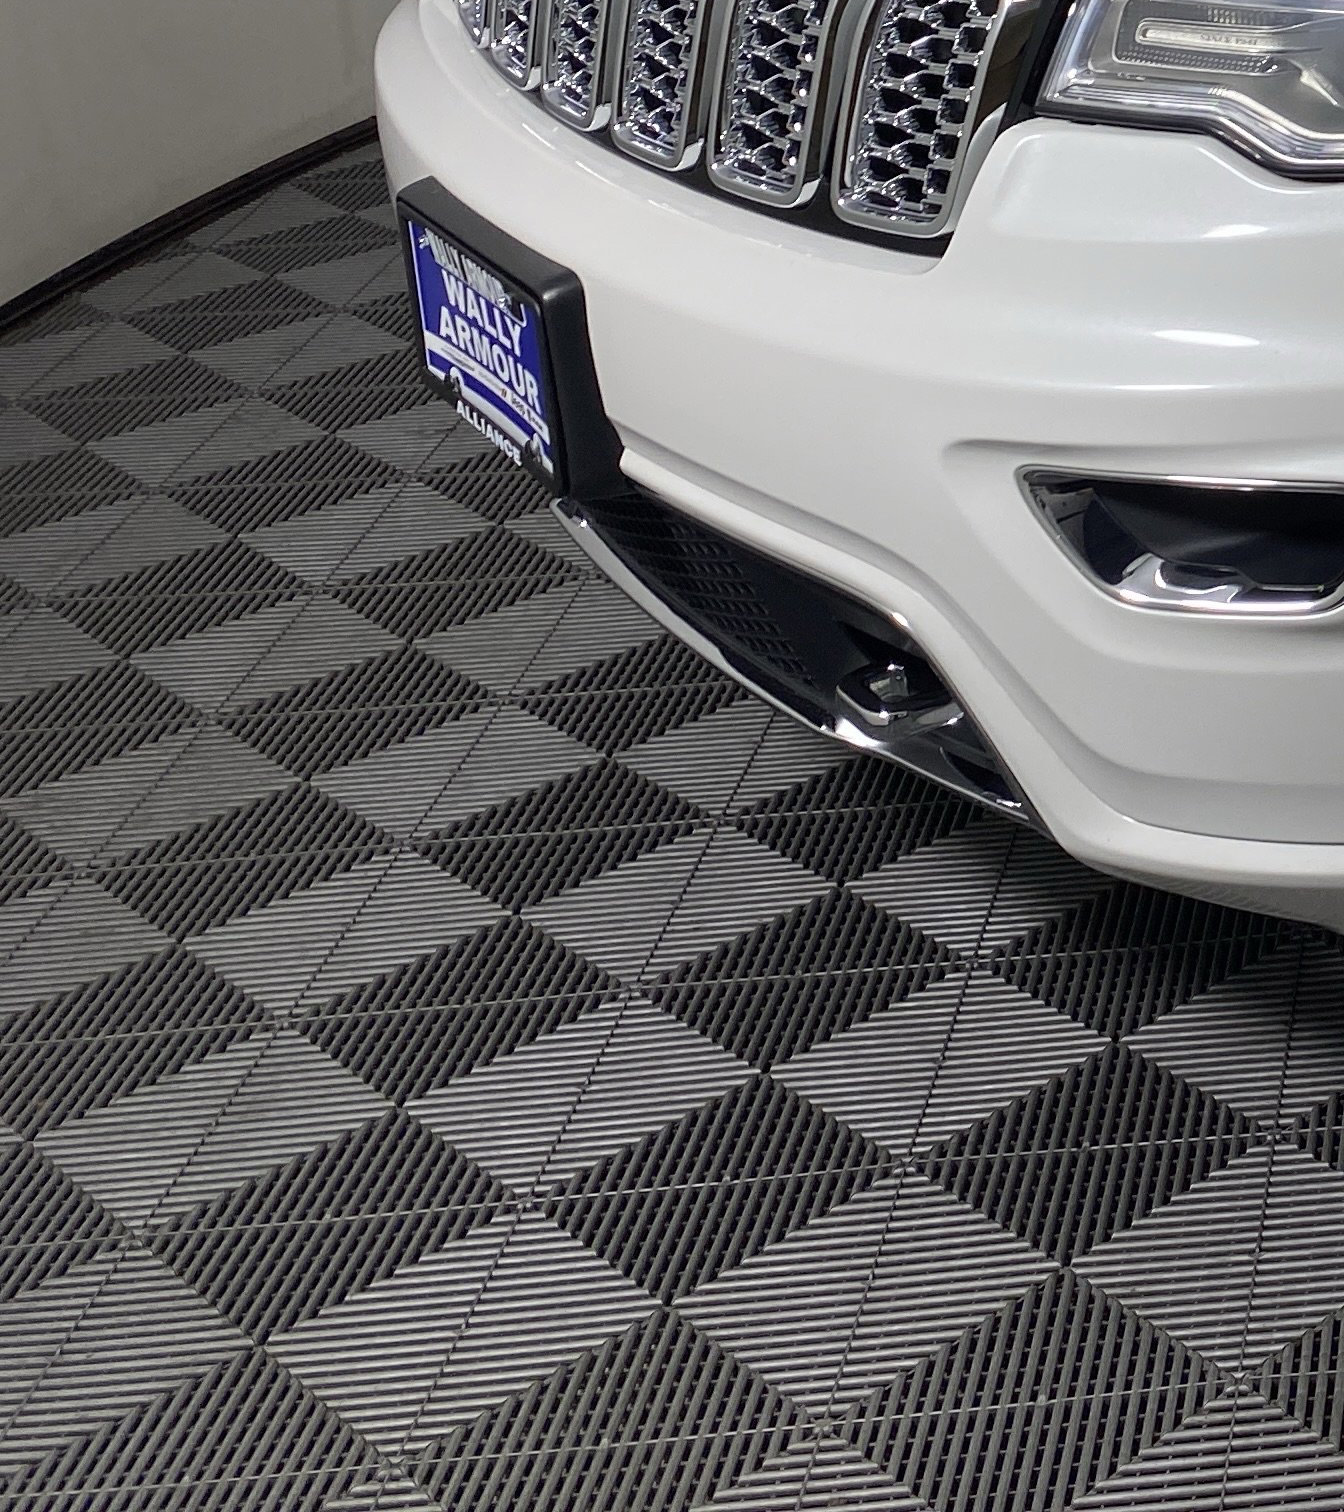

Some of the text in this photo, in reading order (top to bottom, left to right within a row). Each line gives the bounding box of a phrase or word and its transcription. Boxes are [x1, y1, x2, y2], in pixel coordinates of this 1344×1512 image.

[441, 268, 522, 357] WALLY
[439, 306, 542, 416] ARMOUR
[456, 399, 522, 467] ALLIANCE
